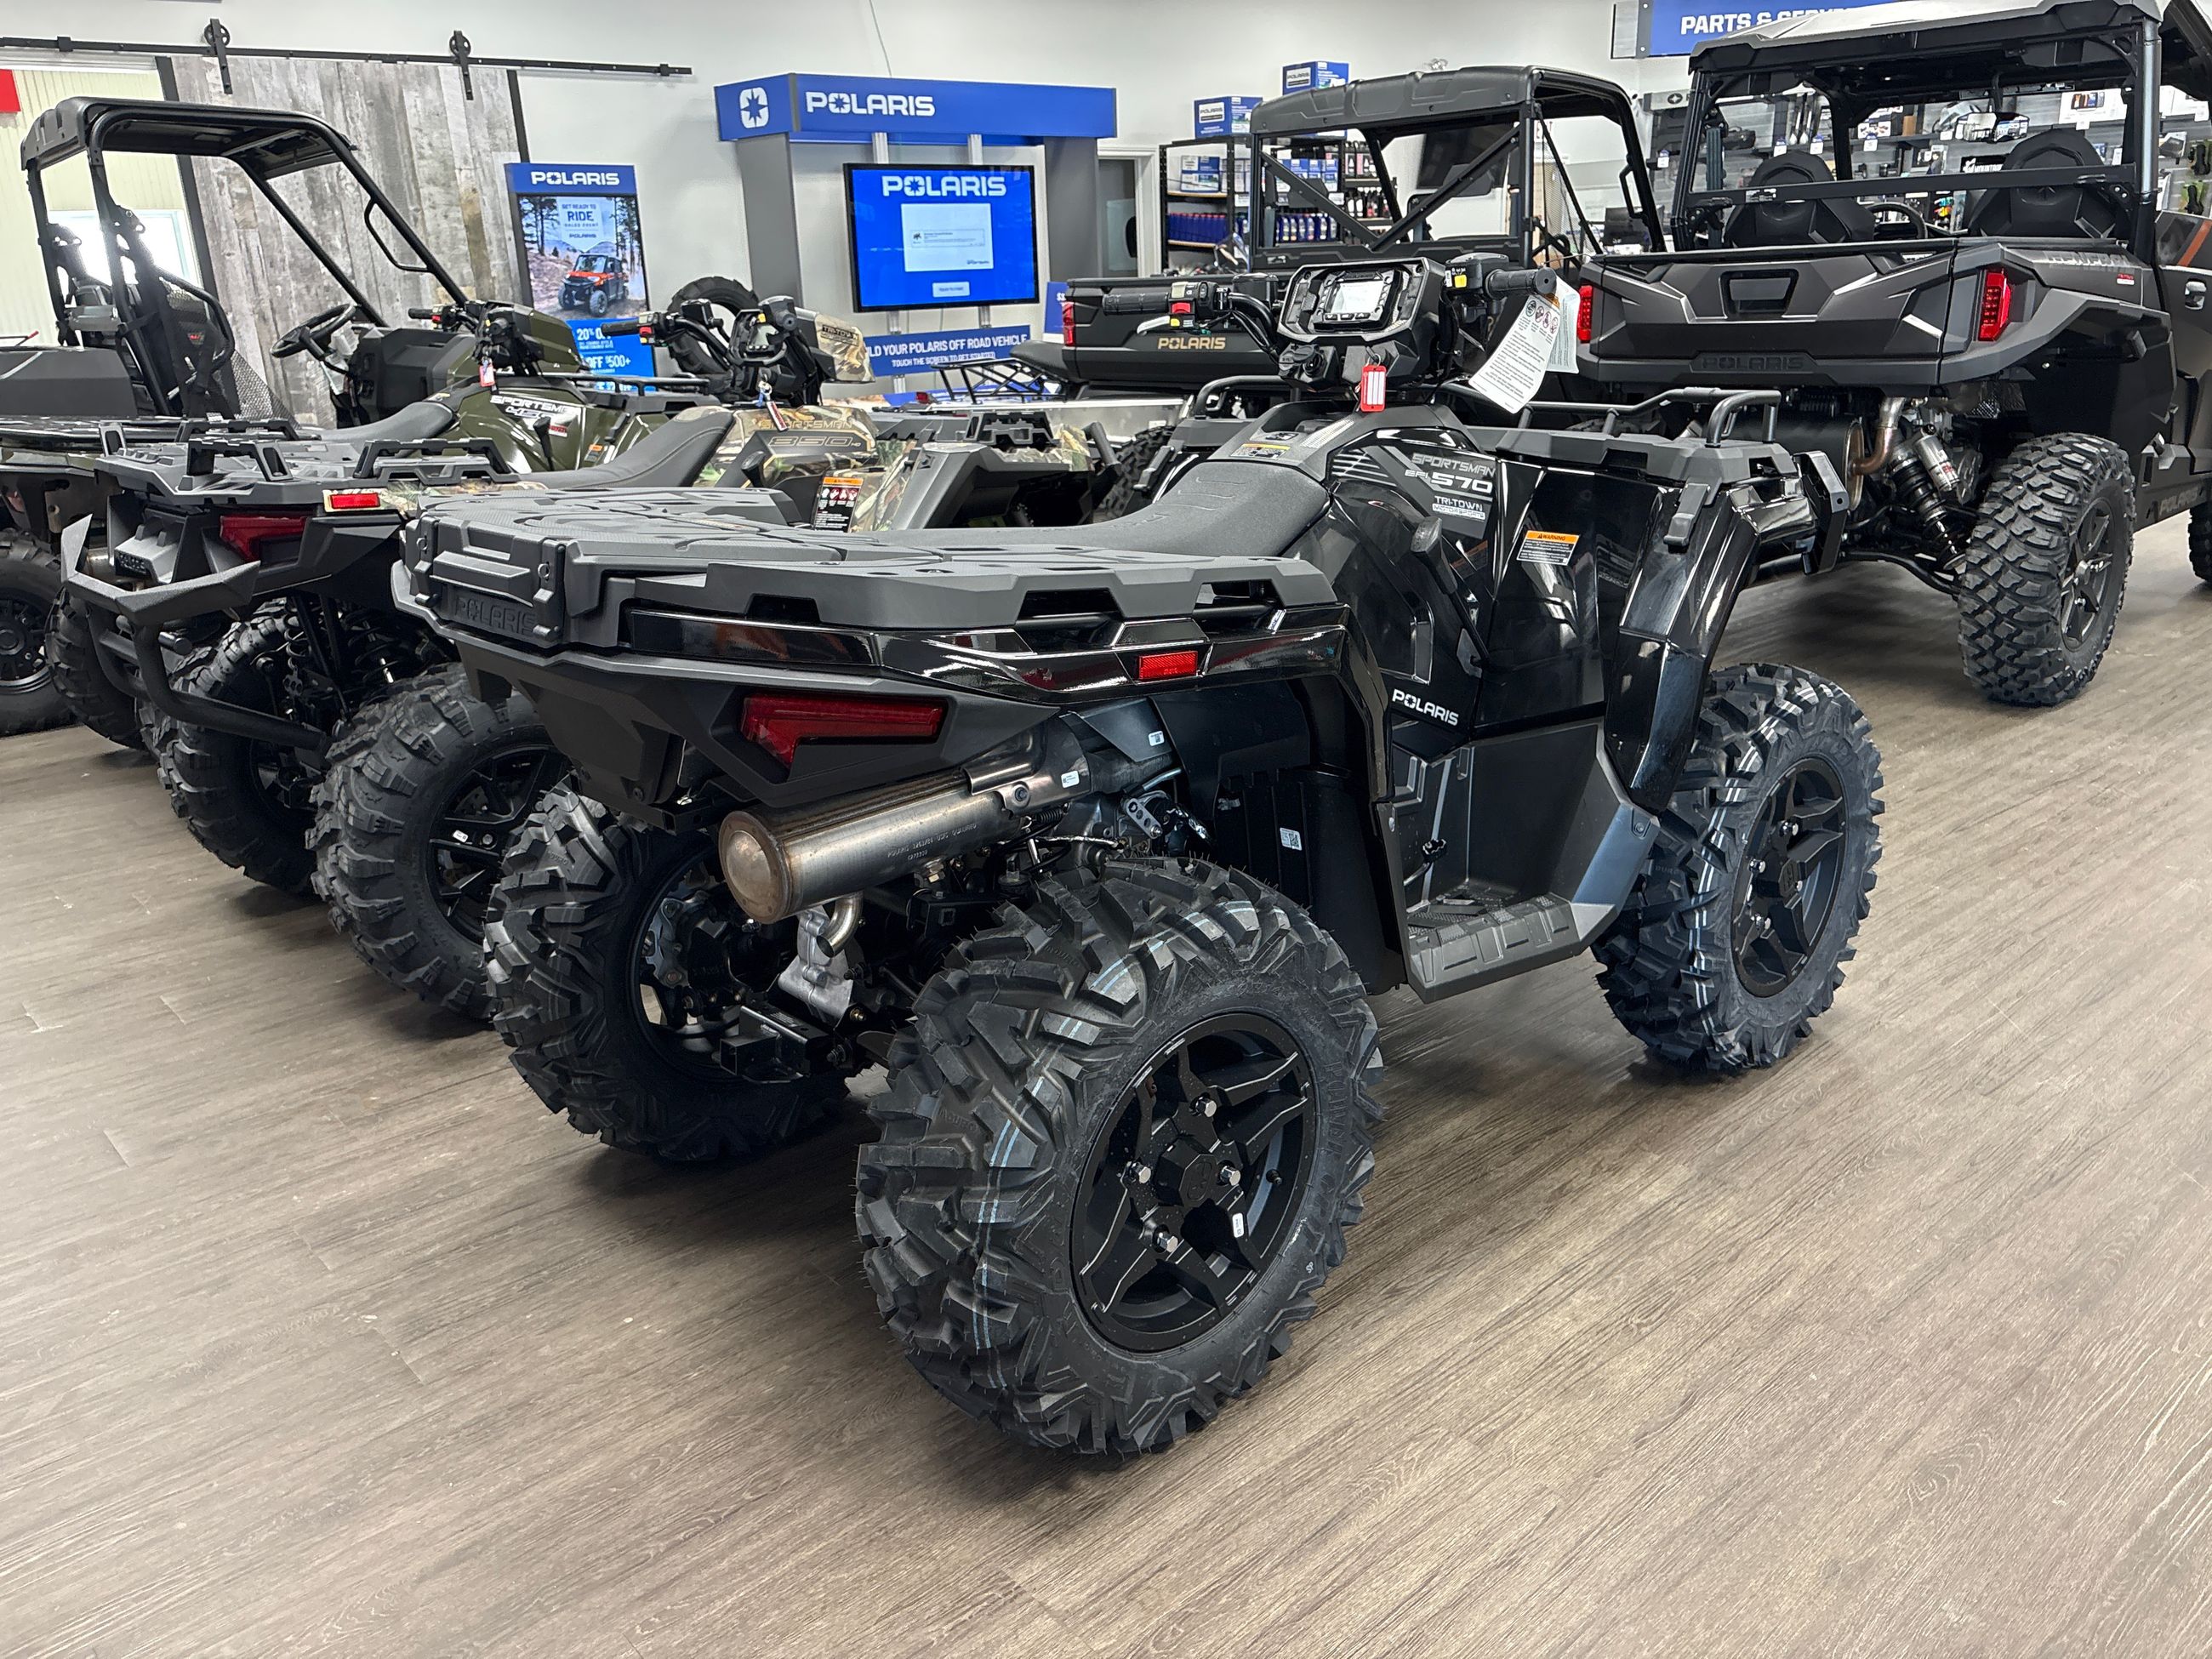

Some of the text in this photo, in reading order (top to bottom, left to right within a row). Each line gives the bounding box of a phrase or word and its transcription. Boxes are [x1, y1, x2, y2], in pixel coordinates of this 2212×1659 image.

[1681, 12, 1751, 35] PARTS
[806, 90, 935, 117] POLARIS
[531, 171, 620, 185] POLARIS
[882, 175, 1006, 197] POLARIS
[567, 211, 594, 221] RIDE
[882, 344, 908, 356] YOUR
[909, 340, 948, 354] POLARIS
[949, 339, 966, 351] OFF
[967, 336, 990, 349] ROAD
[991, 334, 1027, 347] VEHICLE
[1157, 336, 1226, 350] POLARIS
[605, 355, 630, 368] $500+
[892, 358, 912, 368] TOUCH
[913, 356, 925, 366] THE
[1702, 355, 1803, 372] POLARIS
[768, 436, 853, 447] 850
[1412, 453, 1496, 476] SPORTSMAN
[1405, 469, 1493, 493] EFI 570
[1434, 495, 1483, 511] TRI-TOWN
[454, 597, 538, 637] POLARIS
[1392, 688, 1459, 726] POLARIS
